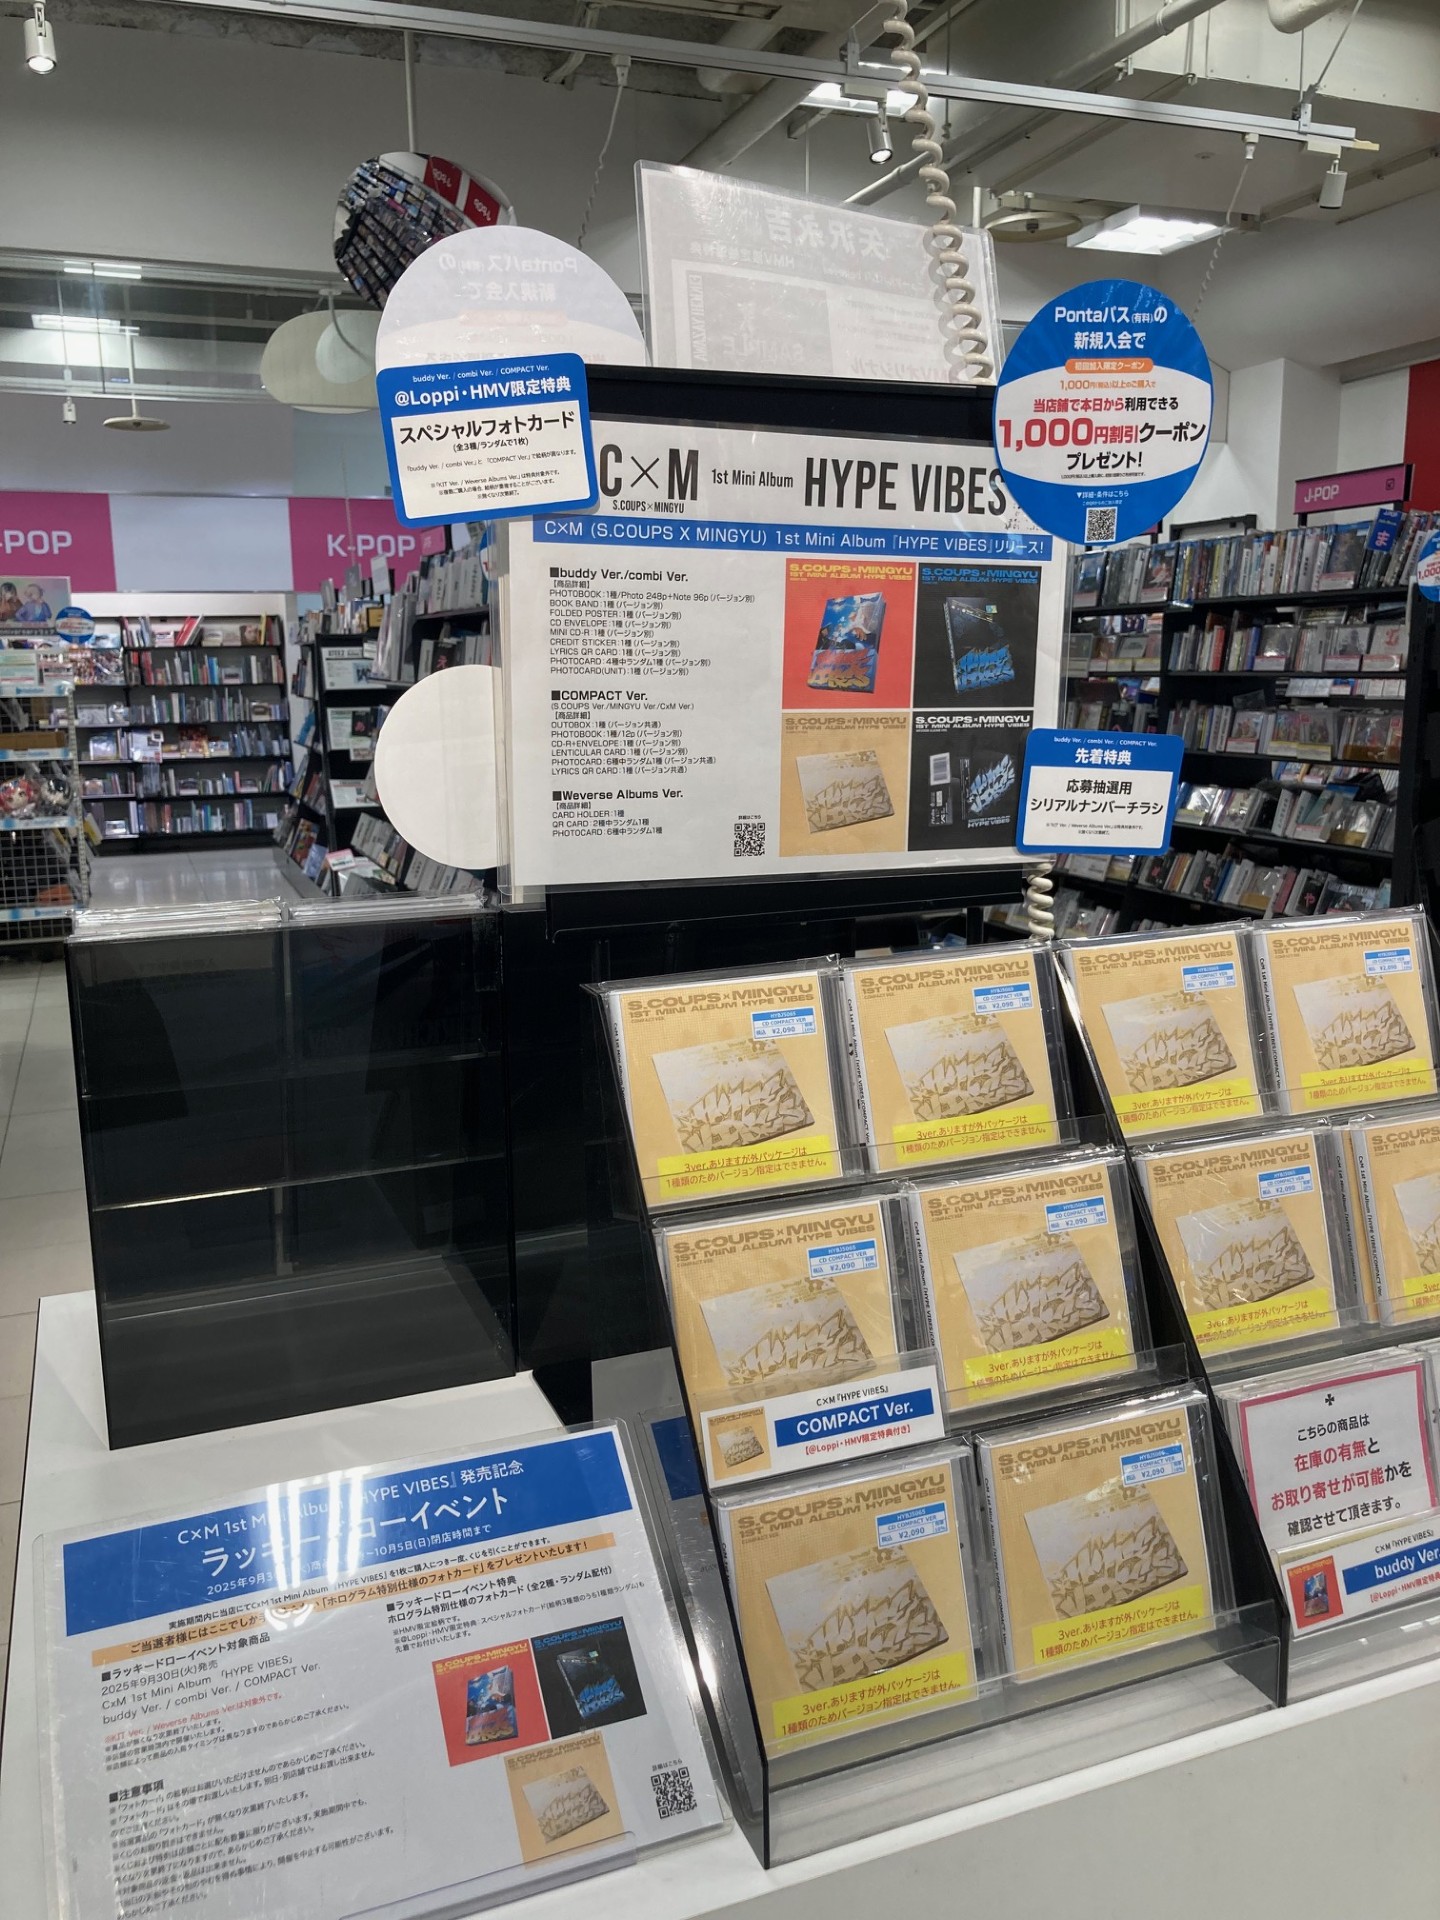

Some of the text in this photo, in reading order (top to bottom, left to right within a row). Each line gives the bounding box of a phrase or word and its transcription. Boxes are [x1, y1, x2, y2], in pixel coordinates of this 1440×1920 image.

[1074, 332, 1146, 350] 新規入会で
[412, 374, 435, 383] buddy
[457, 370, 478, 379] combi
[480, 369, 494, 377] Ver.
[500, 366, 535, 375] COMPACT
[1033, 396, 1179, 412] 当店舗で本日から利用できる
[399, 411, 575, 445] スペシャルフォトカード
[999, 417, 1207, 452] 1,000円割引クーポン
[1066, 452, 1143, 471] プレゼント!
[711, 468, 794, 489] 1st Mini Album
[804, 456, 1006, 516] HYPE VIBES
[1303, 485, 1340, 503] J-POP
[327, 534, 416, 558] K-POP
[590, 522, 674, 541] (S.COUPS
[679, 526, 691, 541] X
[695, 526, 767, 547] MINGYU)
[776, 530, 800, 546] 1st
[805, 531, 836, 548] Mini
[840, 533, 886, 549] Album
[1375, 530, 1391, 547] ま
[559, 567, 689, 582] buddy Ver./combi Ver.
[549, 599, 573, 608] BOOK
[549, 609, 583, 617] FOLDED
[549, 628, 568, 636] MINI
[549, 638, 580, 646] CREDIT
[549, 647, 579, 656] LYRICS
[561, 690, 648, 701] COMPACT Ver.
[1054, 736, 1071, 744] buddy
[1119, 739, 1147, 747] COMPACT
[551, 748, 602, 757] LENTICULAR
[1074, 747, 1132, 766] 先着特典
[551, 767, 580, 775] LYRICS
[562, 788, 684, 801] Weverse Albums Ver.
[1066, 779, 1133, 795] 応募抽選用
[552, 811, 575, 819] CARD
[1030, 798, 1164, 815] シリアルナンバーチラシ
[772, 1026, 796, 1034] ¥2,090
[1132, 1088, 1232, 1111] 3ver.ありますが外パッケージは
[916, 1115, 1028, 1141] 3ver.ありますが外パッケージは
[901, 1126, 1047, 1155] 1種類のためバージョン指定はできません。
[665, 1158, 828, 1189] 1種類のためバージョン指定はできません。
[1275, 1184, 1296, 1194] ¥2,090
[930, 1183, 1104, 1217] 1ST MINI ALBUM HYPE VIBES
[1065, 1218, 1088, 1226] ¥2,090
[675, 1224, 876, 1262] 1ST MINI ALBUM HYPE VIBES
[830, 1262, 855, 1271] ¥2,090
[1207, 1300, 1309, 1328] 3ver.ありますが外パッケージは
[988, 1340, 1103, 1374] 3ver.ありますが外パッケージは
[796, 1401, 914, 1436] COMPACT Ver.
[1297, 1413, 1371, 1442] こちらの商品は
[1293, 1438, 1381, 1473] 在庫の有無と
[1141, 1467, 1165, 1478] ¥2,090
[362, 1485, 400, 1502] HYPE
[1270, 1461, 1413, 1512] お取り寄せが可能かを
[739, 1486, 946, 1539] 1ST MINI ALBUM HYPE VIBES
[897, 1517, 924, 1529] COMPACT
[925, 1514, 937, 1522] VER
[1287, 1496, 1402, 1537] 確認させて頂きます。
[202, 1487, 509, 1577] ラッーローイベント
[224, 1518, 248, 1534] 1st
[898, 1527, 925, 1539] ¥2,090
[1374, 1547, 1440, 1580] buddy Ver.
[270, 1586, 329, 1604] 1st Mini Album
[394, 1575, 517, 1613] ラッキードローイベント特典
[1058, 1600, 1181, 1641] 3ver.ありますが外パッケージは
[1039, 1610, 1200, 1659] 1種類のためバージョン指定はできません。
[111, 1632, 271, 1680] ラッキードローイベント対象商品
[102, 1662, 321, 1725] buddy Ver. combi Ver. COMPACT Ver.
[131, 1692, 148, 1703] 1st
[151, 1685, 175, 1699] Mini
[177, 1675, 212, 1692] Album
[802, 1669, 941, 1716] 3ver.ありますが外パッケージは
[152, 1706, 220, 1732] Weverse Albums
[781, 1681, 961, 1737] 1種類のためバージョン指定はできません。
[118, 1780, 165, 1801] 注意事項
